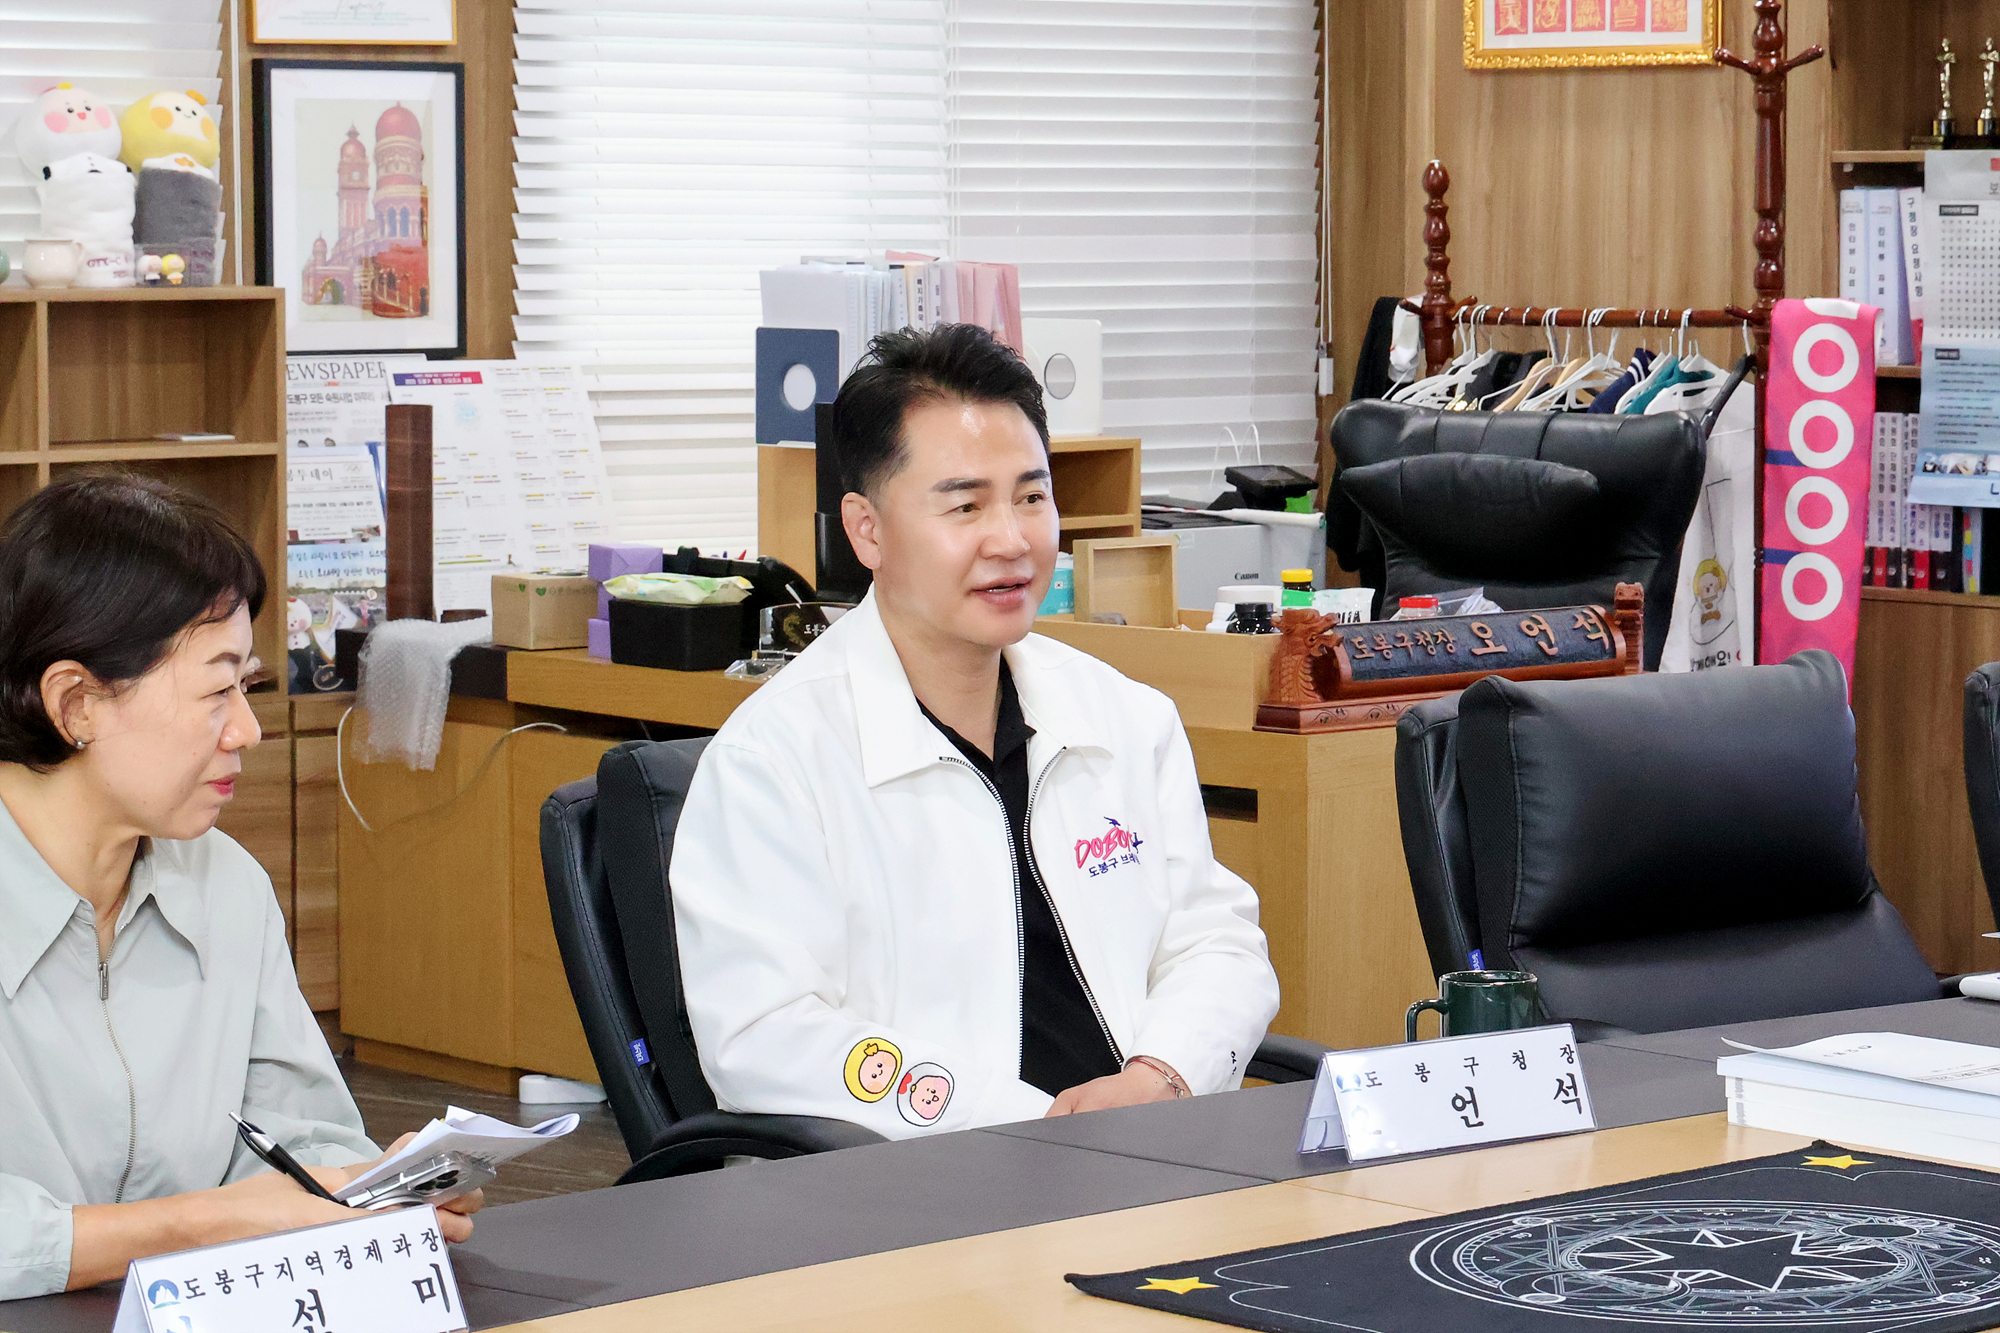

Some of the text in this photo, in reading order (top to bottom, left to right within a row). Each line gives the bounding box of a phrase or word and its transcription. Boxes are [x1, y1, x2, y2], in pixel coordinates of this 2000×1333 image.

[1234, 572, 1260, 581] Canon
[1350, 629, 1457, 660] 도봉구청장
[1089, 857, 1118, 878] 도봉구
[184, 1227, 440, 1300] 도봉구지역경제과장
